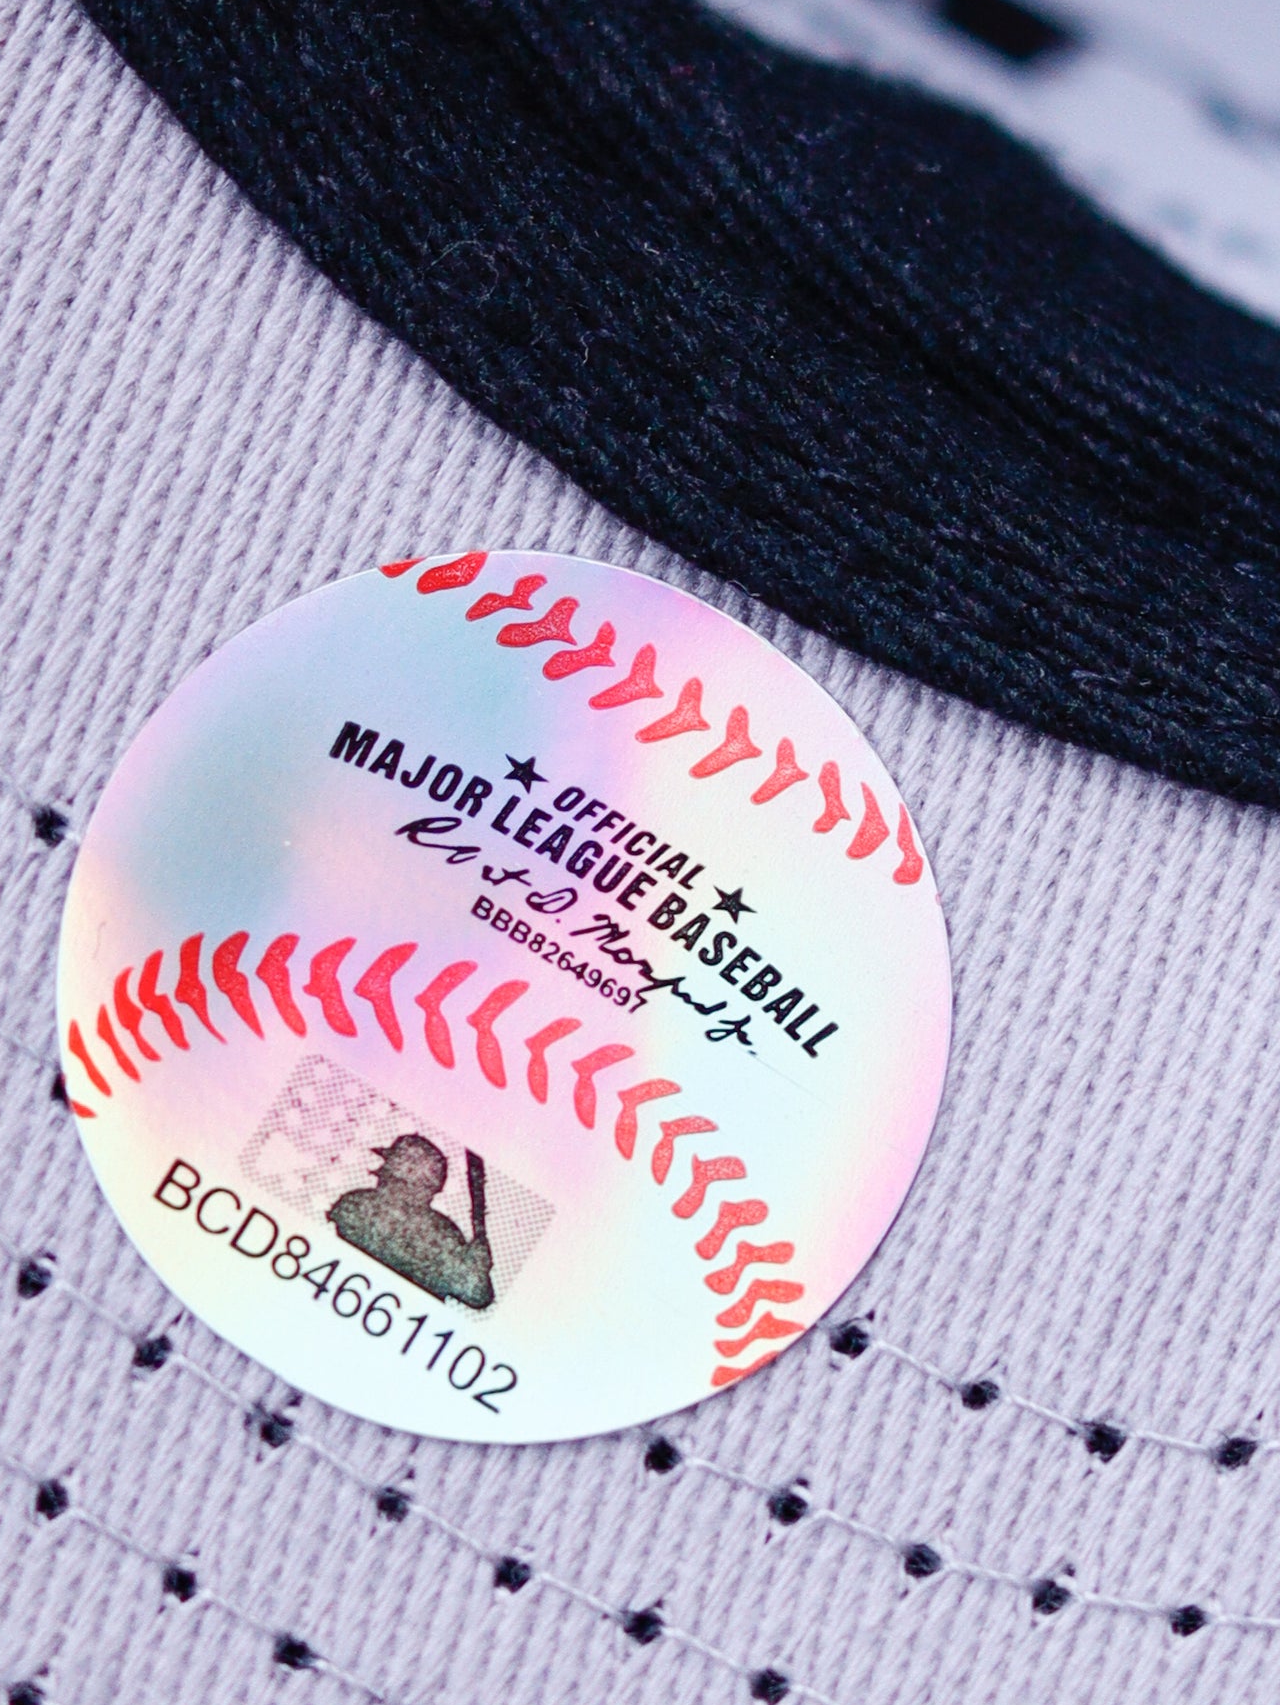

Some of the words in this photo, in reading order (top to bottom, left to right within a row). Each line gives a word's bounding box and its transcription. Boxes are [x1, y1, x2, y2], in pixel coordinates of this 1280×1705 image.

[328, 720, 495, 818] MAJOR
[490, 794, 657, 912] LEAGUE
[647, 891, 840, 1060] BASEBALL
[552, 785, 707, 891] OFFICIAL
[470, 894, 648, 1014] BBB82649697
[152, 1157, 519, 1414] BCD84661102
